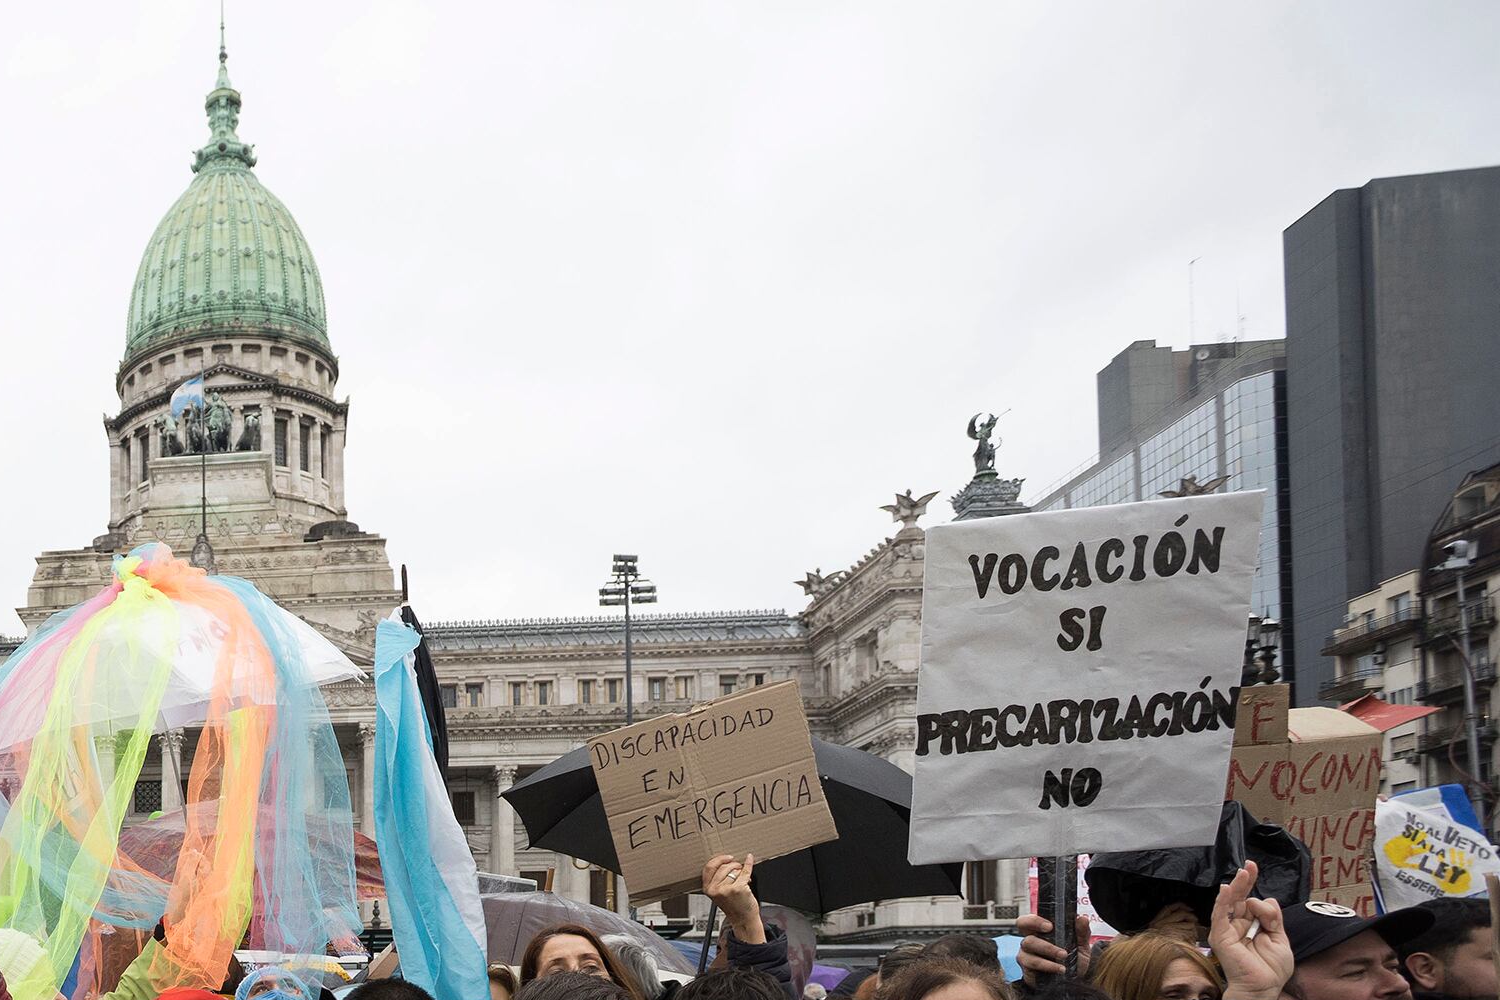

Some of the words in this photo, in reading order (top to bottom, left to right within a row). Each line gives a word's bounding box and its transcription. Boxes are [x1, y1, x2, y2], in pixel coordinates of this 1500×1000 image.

[968, 514, 1225, 599] VOCACIÓN
[1057, 606, 1106, 652] SI
[590, 707, 774, 770] DISCAPACIDAD
[915, 675, 1241, 756] PRECARIZACIÓN
[642, 766, 684, 793] EN
[1038, 767, 1102, 810] NO
[628, 773, 812, 850] EMERGENCIA
[1406, 811, 1425, 831] NO
[1444, 826, 1491, 860] VETO
[1418, 854, 1466, 884] LEY
